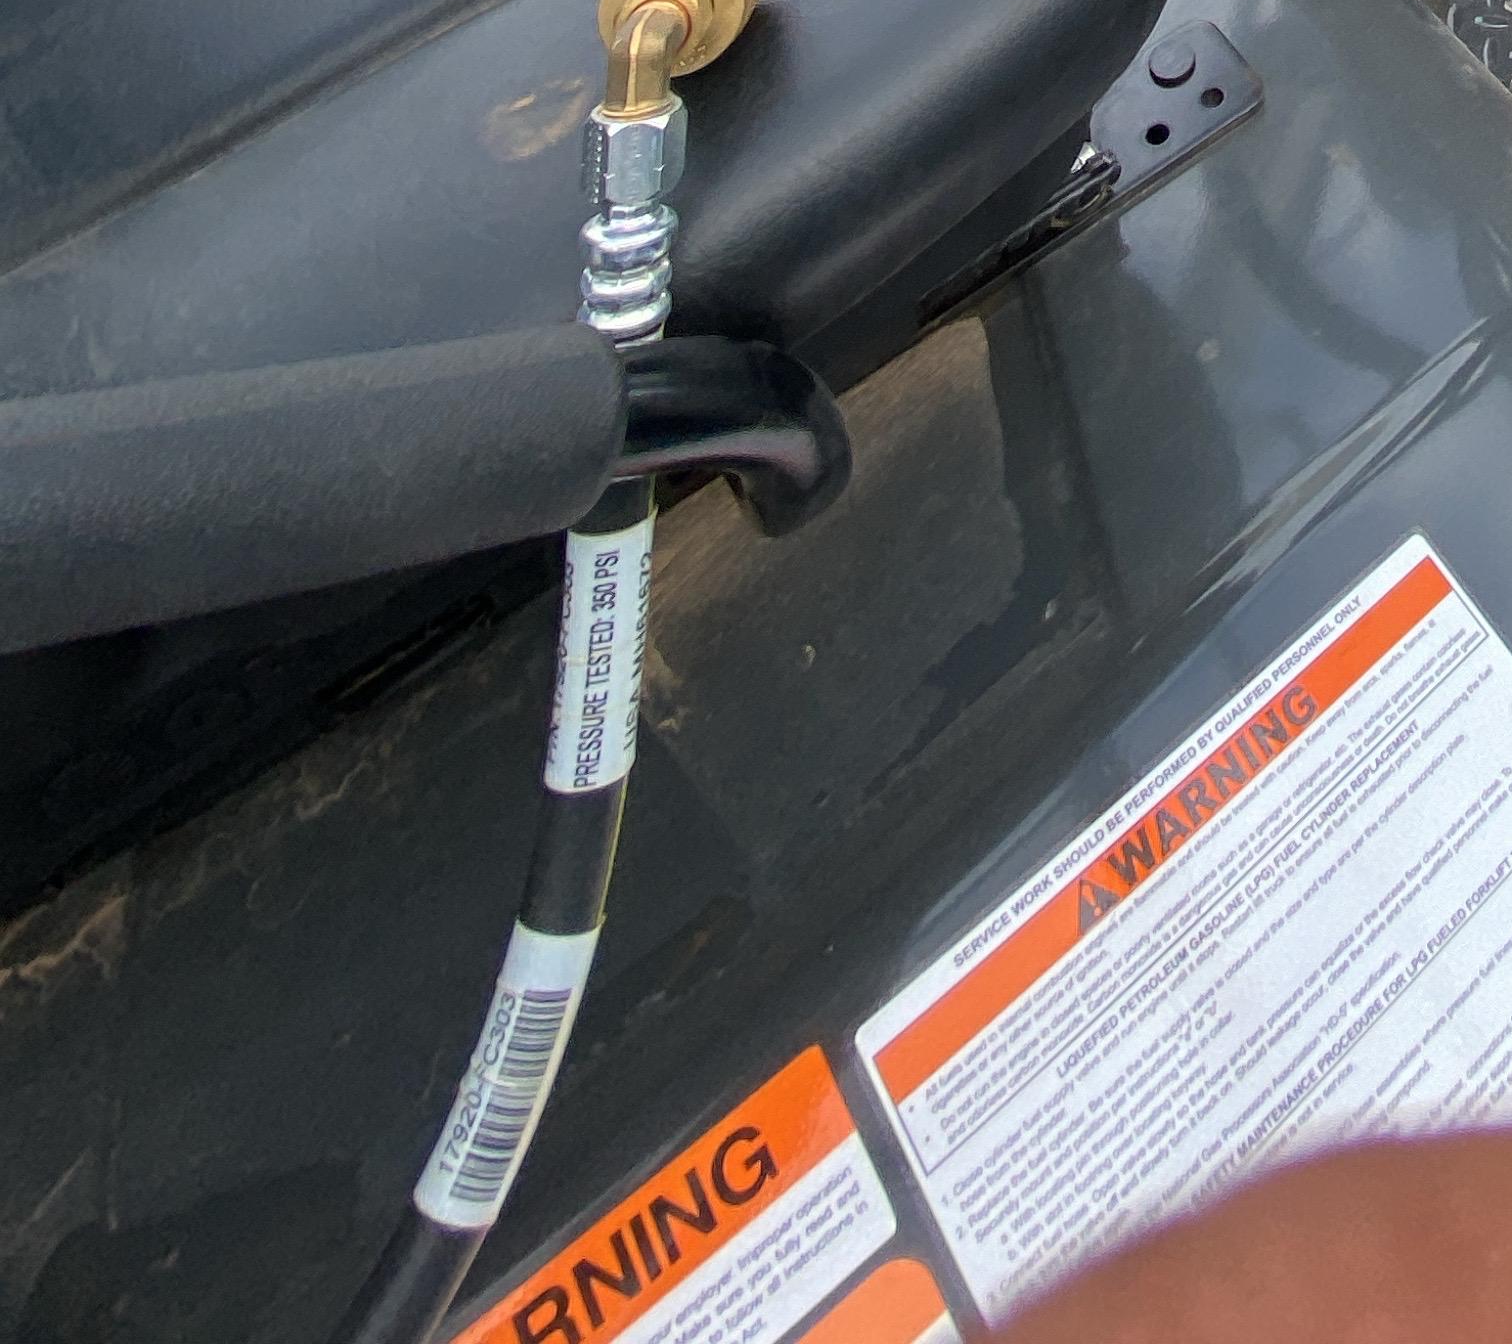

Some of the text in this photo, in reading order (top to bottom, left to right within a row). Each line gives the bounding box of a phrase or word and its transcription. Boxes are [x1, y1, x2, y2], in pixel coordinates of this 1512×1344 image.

[573, 550, 620, 788] PRESSURE TESTED: 350 PSI
[951, 595, 1363, 969] SERVICE WORK SHOULD BE PERFORMED BY QUALIFIED PERSONNEL ONLY
[1105, 678, 1322, 892] WARNING
[1054, 718, 1420, 1080] LIQUEFIED PETROLEUM GASOLINE (LPG) FUEL CYLINDER REPLACEMENT
[438, 990, 516, 1174] 17920-FC303
[1235, 1066, 1320, 1164] MAINTENANCE
[1315, 996, 1386, 1077] PROCEDURE
[1381, 971, 1408, 1003] FOR
[1403, 947, 1431, 980] LPG
[1425, 905, 1469, 957] FUELED
[512, 1126, 778, 1344] RNING
